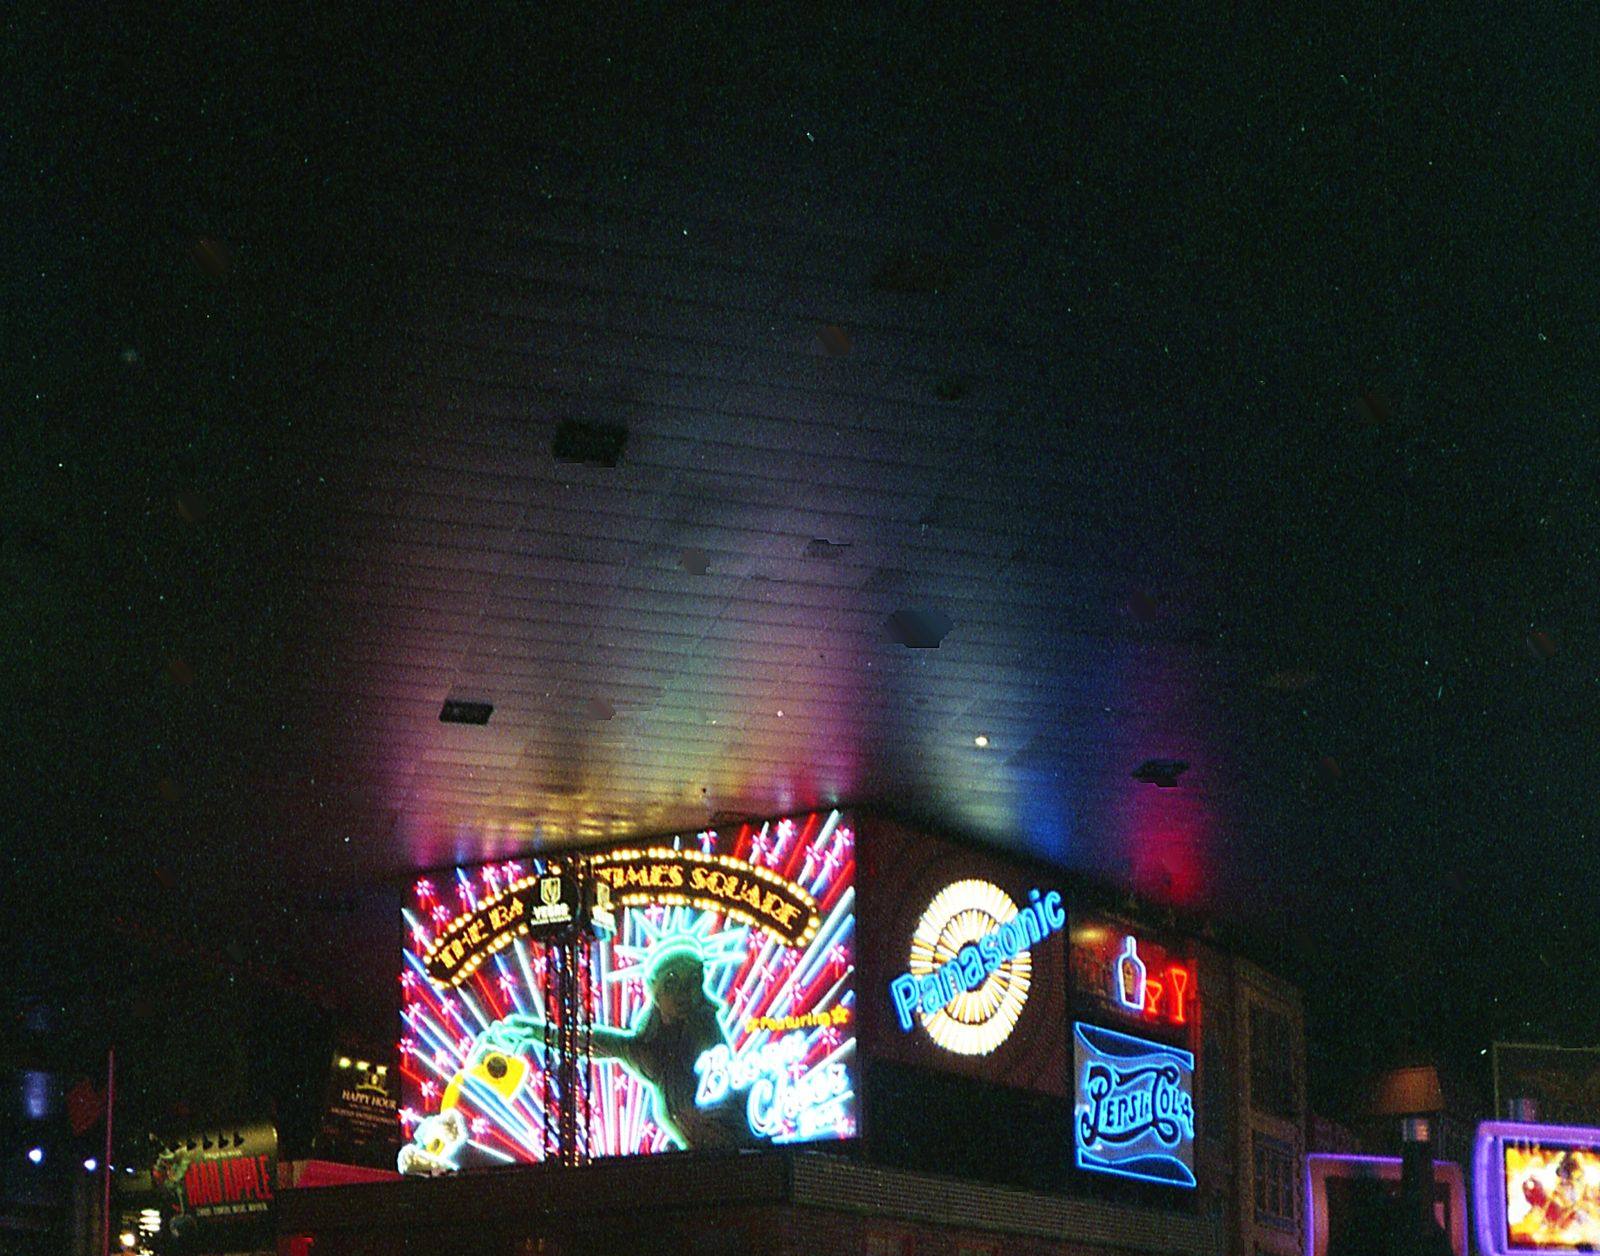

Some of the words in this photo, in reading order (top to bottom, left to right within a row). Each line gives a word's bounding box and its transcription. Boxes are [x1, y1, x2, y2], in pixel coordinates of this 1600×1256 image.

[595, 864, 684, 889] TIMES
[690, 867, 802, 930] SQUARE
[889, 888, 1066, 1032] Panasonic
[341, 1089, 370, 1105] HAPPY
